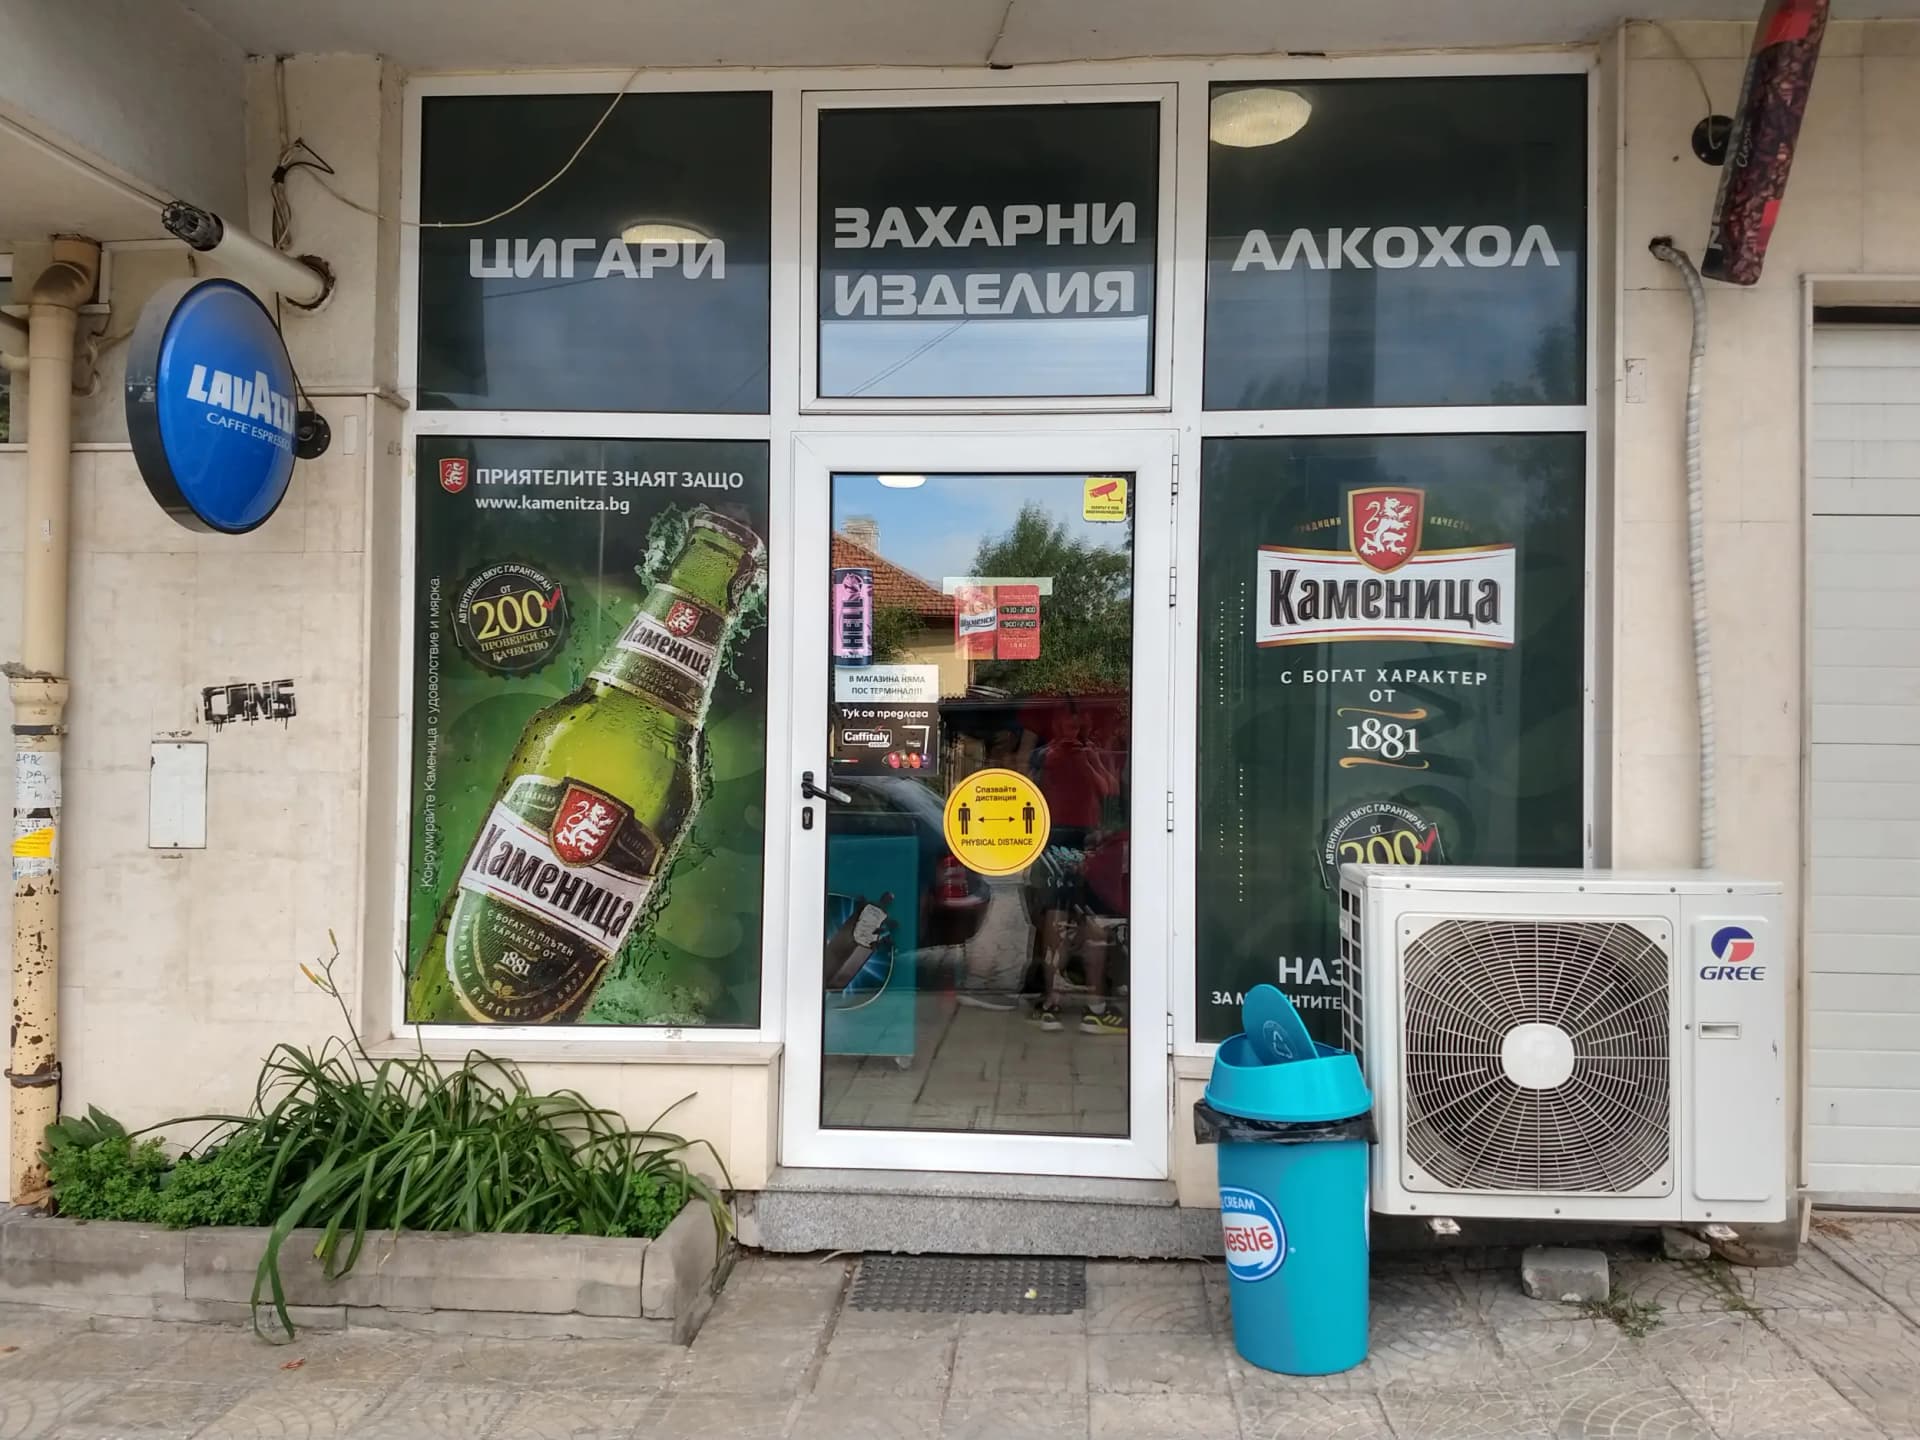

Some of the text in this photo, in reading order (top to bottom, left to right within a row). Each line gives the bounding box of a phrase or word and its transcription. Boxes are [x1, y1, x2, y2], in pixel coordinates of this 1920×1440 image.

[834, 202, 1137, 249] ЗАХАРНИ
[1231, 225, 1561, 271] АЛКОХОЛ
[469, 238, 726, 280] ЦИГАРИ
[834, 270, 1135, 316] ИЗДЕЛИЯ
[476, 469, 743, 490] ПРИЯТЕЛИТЕ ЗНАЯТ ЗАЩО
[475, 496, 630, 515] www.kamenitza.bg
[482, 565, 504, 579] ВКУС
[504, 565, 552, 591] ГАРАНТИРАН
[500, 585, 512, 594] ОТ
[1269, 569, 1501, 630] Каменица
[430, 621, 440, 629] и
[472, 590, 548, 640] 200
[843, 599, 864, 648] HELL
[428, 632, 441, 714] удоволствие
[856, 675, 900, 683] МАГАЗИНА
[1280, 669, 1488, 686] С БОГАТ ХАРАКТЕР
[851, 687, 869, 695] ПОС
[1369, 690, 1396, 703] ОТ
[841, 709, 860, 719] Тук
[876, 710, 929, 720] предлага
[844, 731, 889, 744] Caffitaly
[1347, 718, 1421, 759] 1881
[424, 728, 438, 791] Каменица
[975, 785, 1017, 795] Спазвайте
[975, 794, 1017, 803] дистанция
[1326, 803, 1427, 866] АВТЕНТИЧЕН ВКУС ГАРАНТИРАН
[1369, 824, 1382, 834] ОТ
[421, 794, 437, 887] Консумирайте
[961, 838, 1033, 847] PHYSICAL DISTANCE
[1340, 830, 1422, 866] 200
[472, 824, 634, 939] Каменица
[500, 951, 531, 977] 1881
[1699, 966, 1767, 981] GREE
[1211, 992, 1234, 1005] ЗА
[1223, 1196, 1256, 1211] CREAM
